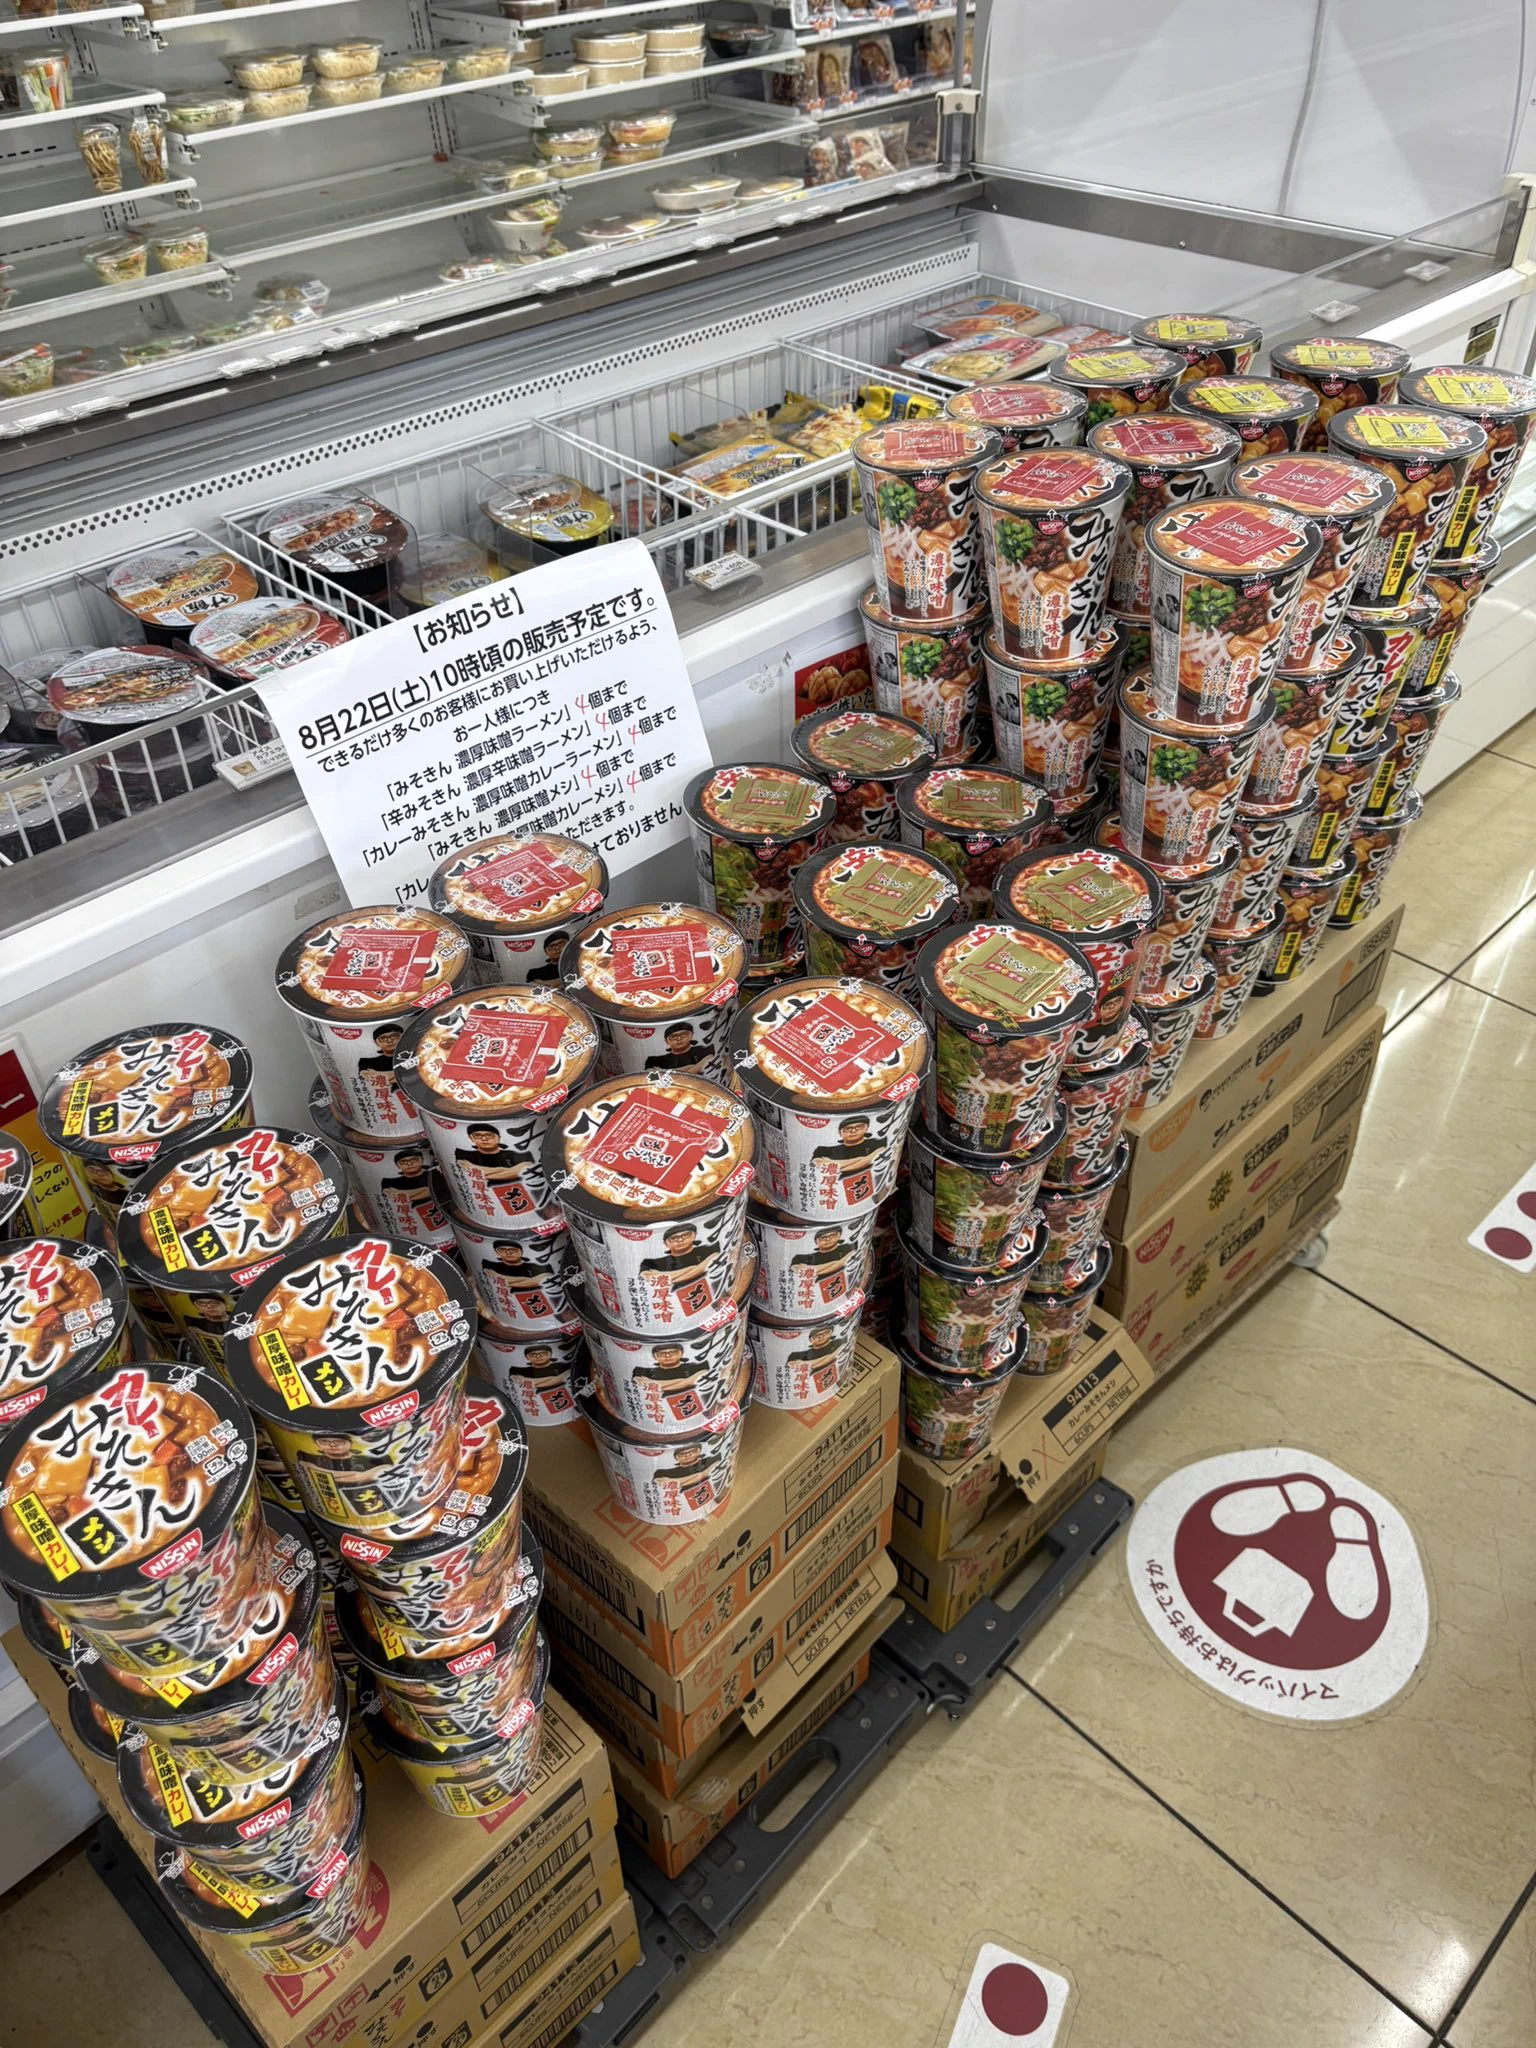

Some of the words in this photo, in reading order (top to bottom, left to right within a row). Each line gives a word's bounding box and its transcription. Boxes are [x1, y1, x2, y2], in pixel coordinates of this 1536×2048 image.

[1041, 522, 1064, 531] NISSIN
[929, 553, 946, 607] 濃厚味噌
[1069, 516, 1115, 640] みそきん
[413, 586, 525, 653] 【お知らせ】
[1045, 595, 1063, 649] 濃厚味噌
[1290, 602, 1318, 658] 濃厚味噌
[298, 587, 655, 750] 8月22日(土)10時頃の販売予定です。
[1227, 658, 1254, 713] 濃厚味噌
[317, 618, 657, 774] できるだけ多くのお客様にお買い上げいただけるよう、
[1338, 654, 1386, 745] みそきん
[453, 689, 551, 743] お一人様につき
[386, 761, 452, 802] 「みそきん
[454, 704, 571, 769] 濃厚味噌ラーメン」
[381, 783, 461, 831] 「辛みそきん
[463, 719, 592, 791] 濃厚辛味噌ラーメン」
[362, 806, 470, 868] 「カレーみそきん
[472, 730, 622, 813] 濃厚味噌カレーラーメン」
[427, 821, 492, 861] 「みそきん
[494, 774, 580, 828] 濃厚味噌メシ」
[577, 891, 598, 912] NISSIN
[420, 985, 451, 1007] NISSIN
[709, 982, 734, 1004] NISSIN
[333, 1028, 361, 1037] NISSIN
[625, 1027, 653, 1035] NISSIN
[120, 1039, 181, 1134] みそきん
[370, 1075, 397, 1124] 濃厚味噌
[529, 1086, 567, 1110] NISSIN
[888, 1076, 918, 1100] NISSIN
[93, 1106, 115, 1132] メシ
[797, 1116, 828, 1125] NISSIN
[114, 1144, 155, 1158] NISSIN
[725, 1166, 751, 1195] NISSIN
[820, 1163, 839, 1210] 濃厚味噌
[848, 1175, 869, 1200] メシ
[180, 1152, 292, 1254] みそきん
[505, 1186, 526, 1212] メシ
[152, 1209, 182, 1270] 濃厚味噌カレー
[193, 1230, 220, 1261] メシ
[618, 1230, 650, 1239] NISSIN
[1142, 1228, 1173, 1257] NISSIN
[526, 1295, 547, 1317] メシ
[650, 1275, 674, 1323] 濃厚味噌
[682, 1284, 707, 1310] メシ
[797, 1268, 816, 1309] 濃厚味噌
[287, 1263, 420, 1391] みそきん
[703, 1303, 736, 1330] NISSIN
[263, 1333, 306, 1407] 濃厚味噌カレー
[313, 1361, 345, 1396] メシ
[793, 1364, 812, 1400] 濃厚味噌
[0, 1393, 41, 1417] ISSIN
[550, 1391, 569, 1410] メシ
[643, 1382, 664, 1424] 濃厚味噌
[679, 1395, 697, 1417] メシ
[1066, 1372, 1101, 1406] 94113
[369, 1396, 416, 1423] NISSIN
[710, 1406, 737, 1432] NISSIN
[1074, 1421, 1096, 1446] 6CUPS
[37, 1404, 196, 1539] みそきん
[663, 1481, 682, 1516] 濃厚味噌
[18, 1499, 72, 1574] 濃厚味噌カレー
[80, 1517, 115, 1554] メシ
[344, 1538, 384, 1558] NISSIN
[149, 1538, 199, 1575] NISSIN
[1144, 1557, 1340, 1701] マイバッグはお持ちですか
[255, 1641, 297, 1682] NISSIN
[454, 1648, 492, 1673] NISSIN
[805, 1635, 829, 1662] 6CUPS
[503, 1702, 533, 1736] NISSIN
[748, 1698, 765, 1720] 押す
[245, 1806, 288, 1837] NISSIN
[494, 1815, 546, 1867] 94113
[314, 1858, 347, 1895] NISSIN
